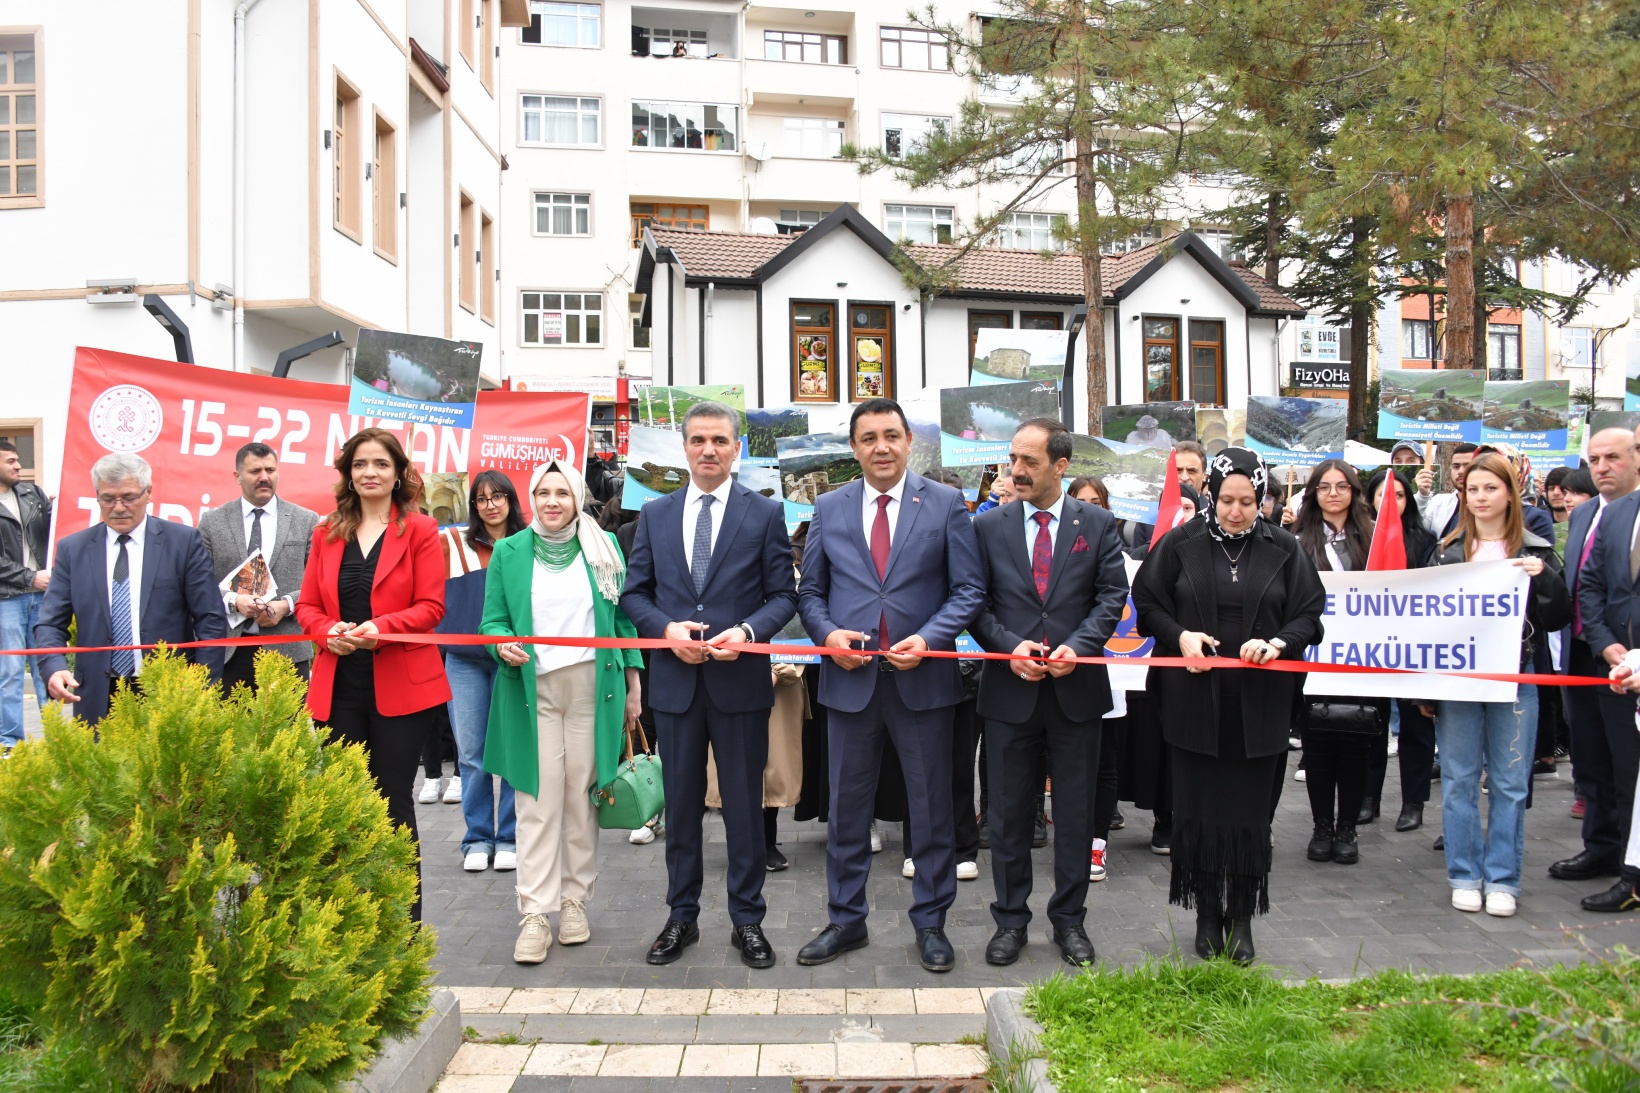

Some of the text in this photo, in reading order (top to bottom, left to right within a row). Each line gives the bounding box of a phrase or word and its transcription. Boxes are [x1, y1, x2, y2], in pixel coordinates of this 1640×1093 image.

[1318, 331, 1337, 342] EVDE
[1295, 368, 1350, 384] FizyOHa
[361, 396, 463, 415] Turizm İnsanları Kaynaştıran
[376, 409, 406, 419] Kuvvetli
[408, 413, 428, 422] Sevgi
[429, 416, 456, 426] Bağıdır
[180, 398, 311, 465] 15-22
[1400, 422, 1421, 430] Turistin
[1444, 423, 1459, 431] Değil
[1394, 431, 1463, 440] Memnuniyeti Önemlidir
[1530, 433, 1546, 441] Değil
[324, 412, 471, 475] NAN
[952, 446, 974, 454] Turizm
[976, 443, 1007, 452] İnsanları
[481, 442, 561, 463] GÜMÜŞHANE
[969, 454, 997, 463] Kuvvetli
[1111, 498, 1149, 512] Kaynaştıran
[1117, 509, 1142, 520] Bağıdır
[1345, 586, 1519, 617] ÜNİVERSİTESİ
[1330, 636, 1476, 670] FAKÜLTESİ
